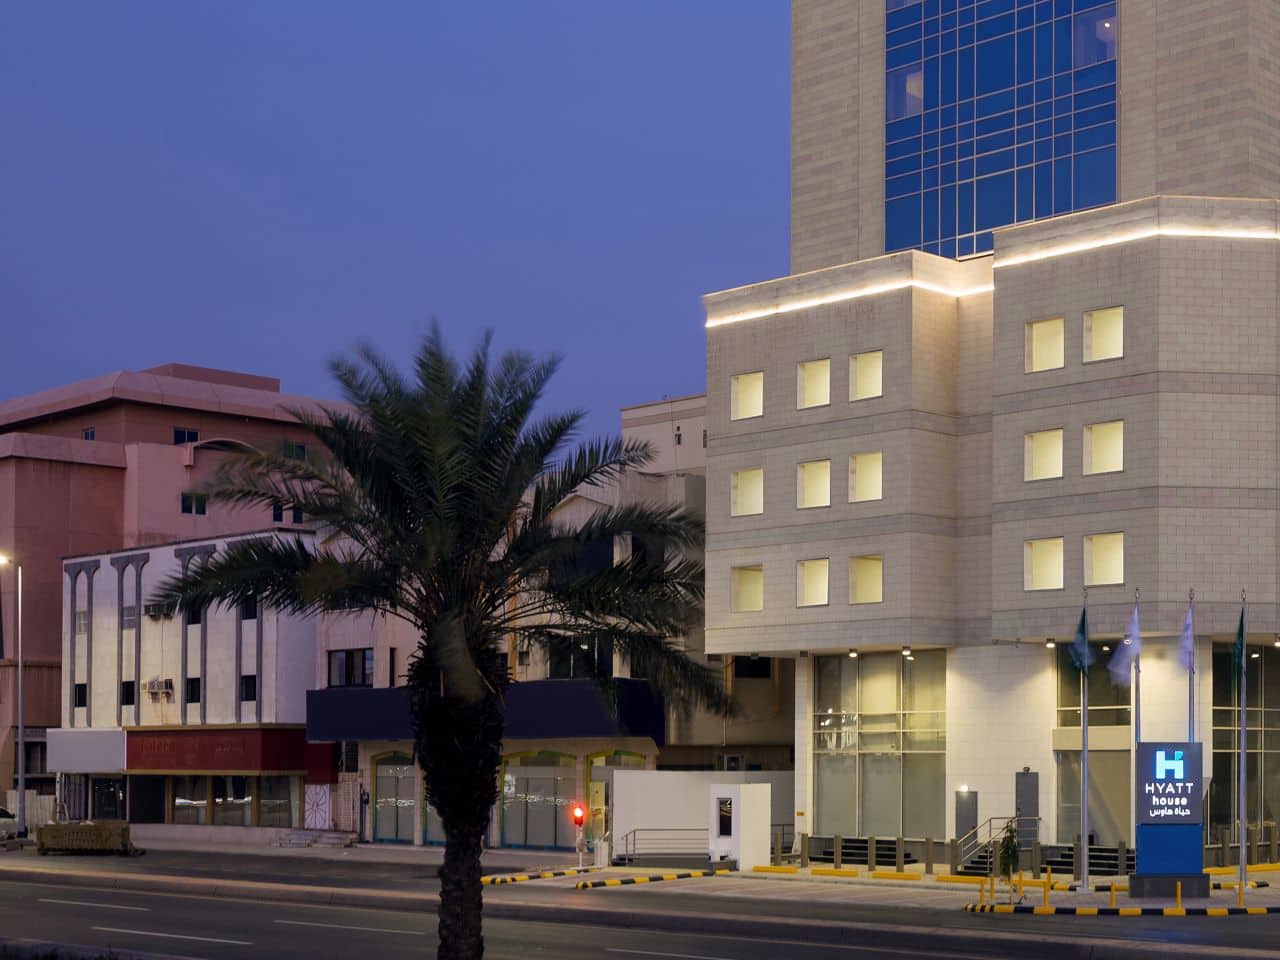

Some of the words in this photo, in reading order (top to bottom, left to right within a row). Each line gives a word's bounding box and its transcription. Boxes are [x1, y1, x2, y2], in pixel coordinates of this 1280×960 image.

[1145, 783, 1194, 794] HYATT
[1152, 795, 1187, 806] house
[1149, 806, 1173, 817] هاوس
[1174, 806, 1191, 817] حياة
